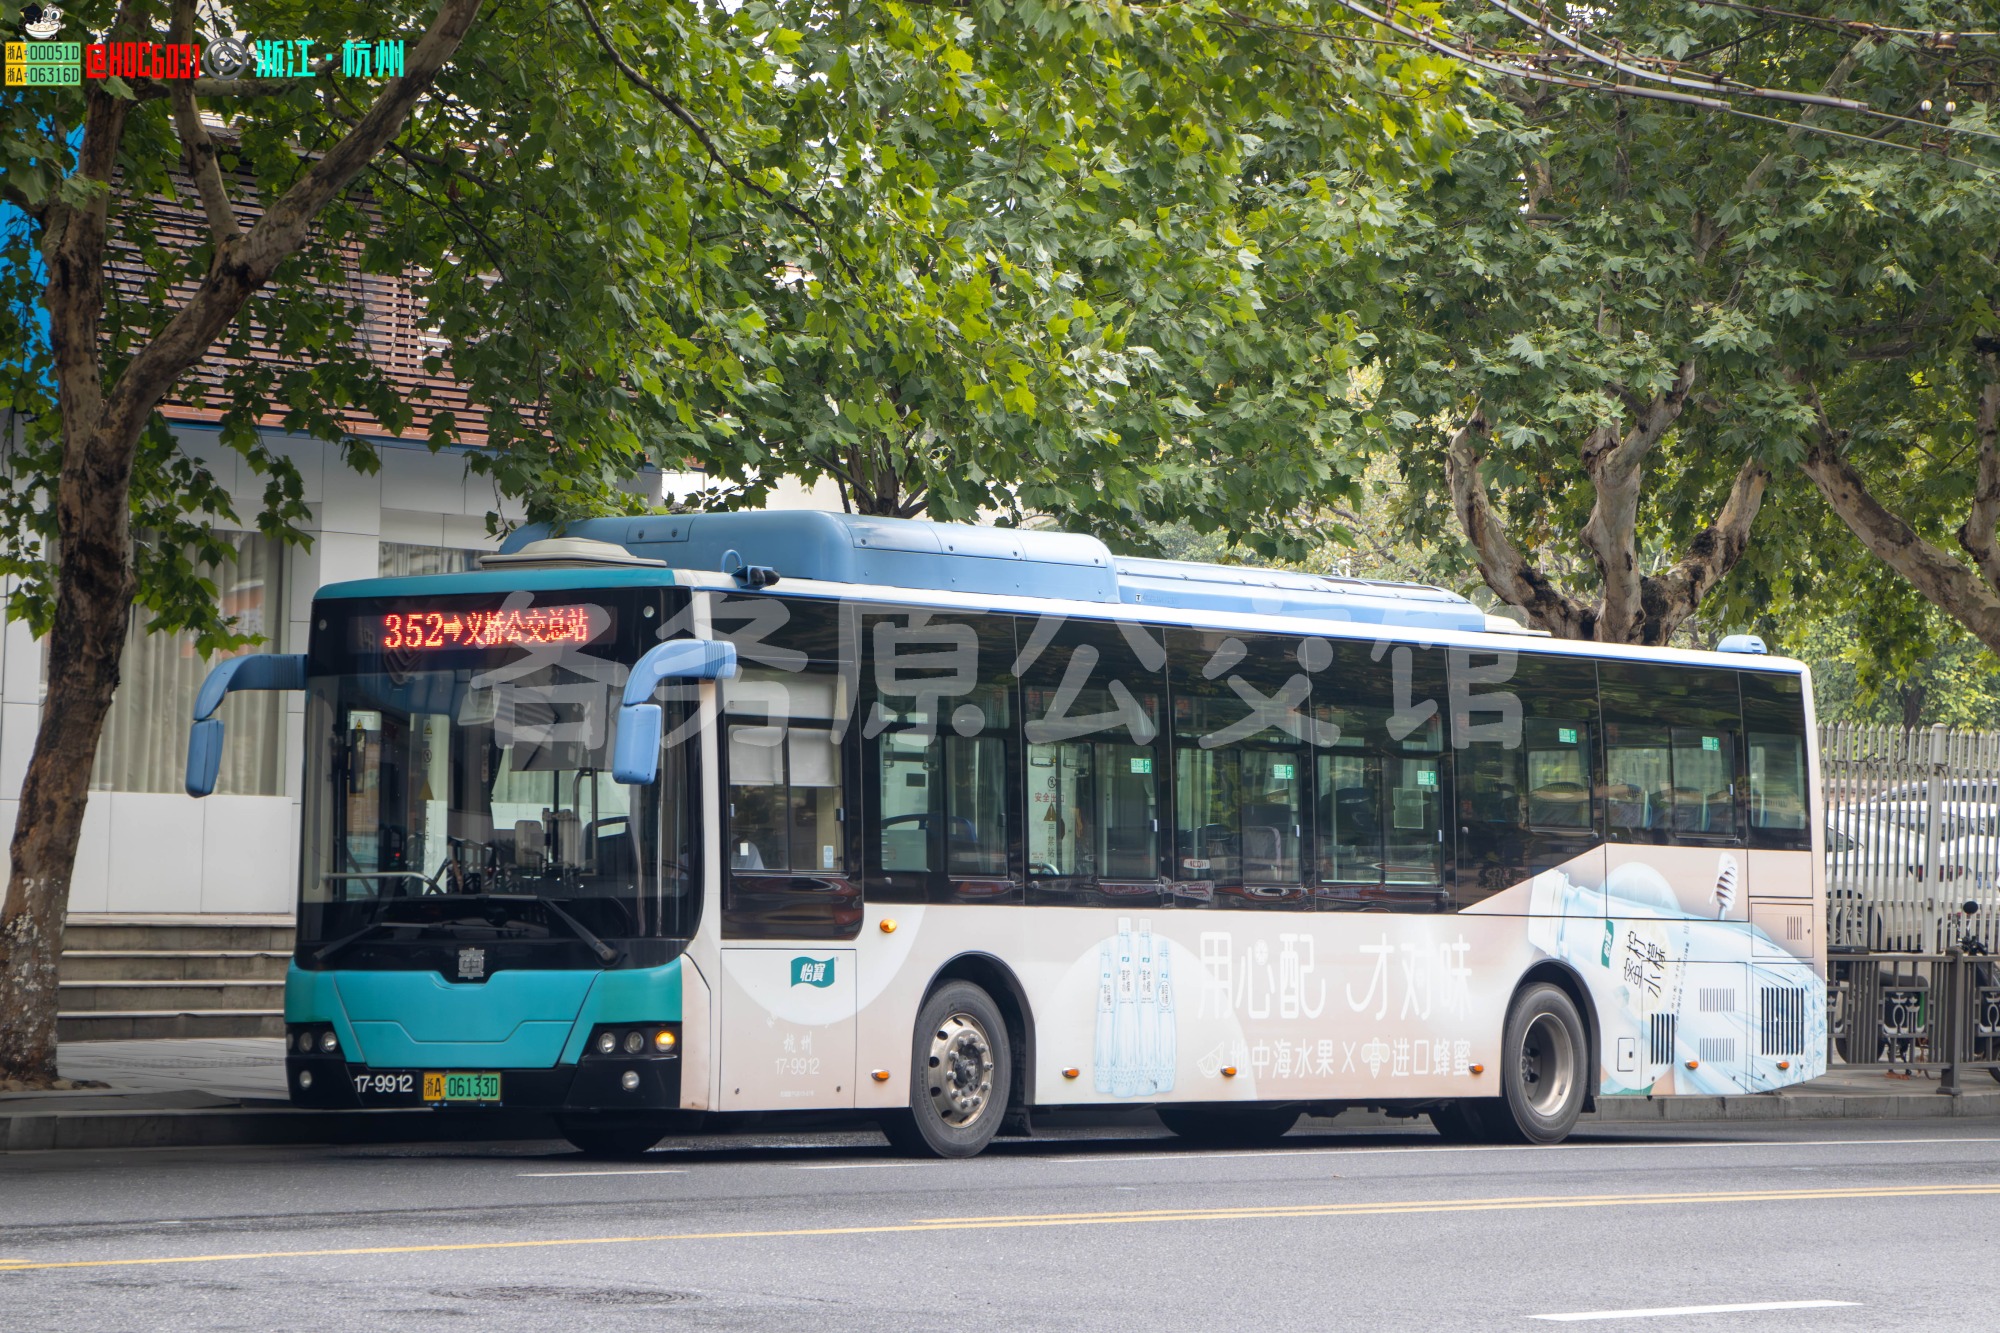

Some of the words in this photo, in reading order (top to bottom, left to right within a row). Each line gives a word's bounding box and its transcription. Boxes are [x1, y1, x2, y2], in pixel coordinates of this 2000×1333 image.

[384, 612, 444, 648] 352
[463, 607, 589, 647] 义桥公交总站
[1198, 930, 1327, 1021] 用心配
[1345, 931, 1474, 1022] 才对味
[783, 1029, 813, 1055] 杭州
[1230, 1038, 1334, 1079] 地中海水果
[1391, 1037, 1471, 1078] 进口蜂蜜
[775, 1056, 820, 1075] 17-9912
[353, 1074, 413, 1094] 17-9912
